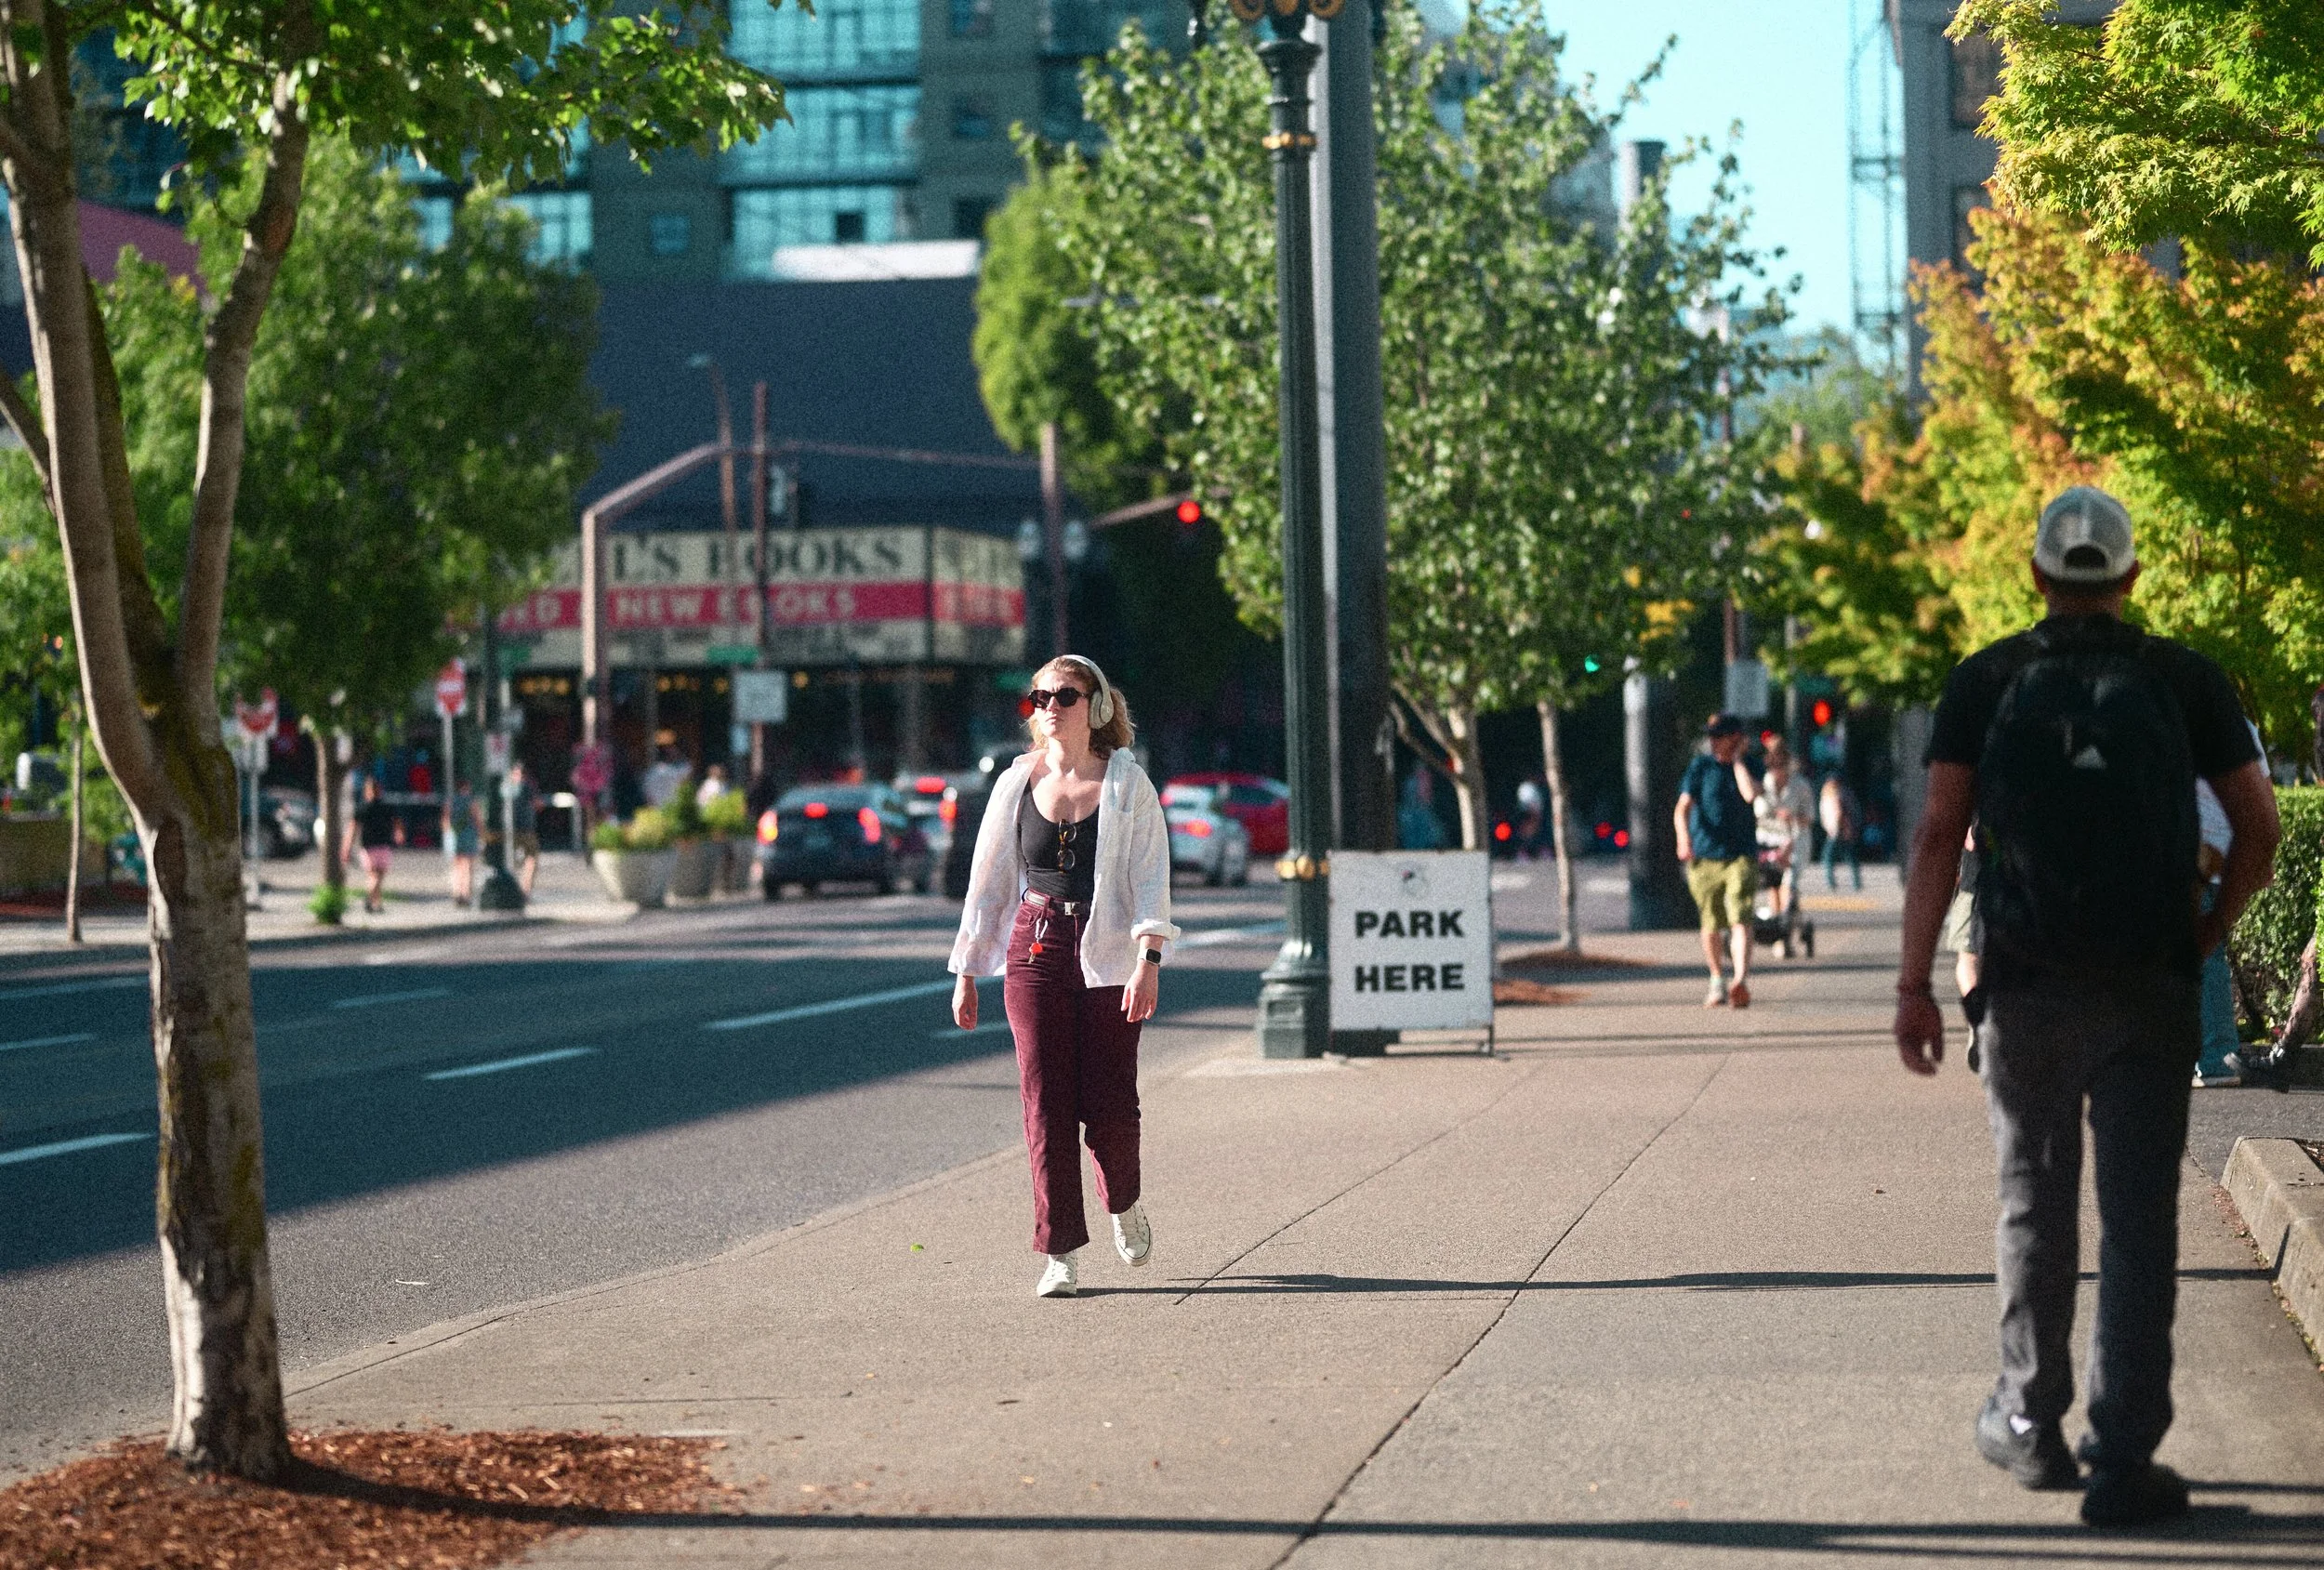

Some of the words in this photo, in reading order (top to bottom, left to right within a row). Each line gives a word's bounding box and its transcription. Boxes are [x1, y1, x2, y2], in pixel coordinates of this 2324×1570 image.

[615, 593, 704, 621] NEW
[1354, 910, 1464, 938] PARK
[1354, 964, 1465, 992] HERE
